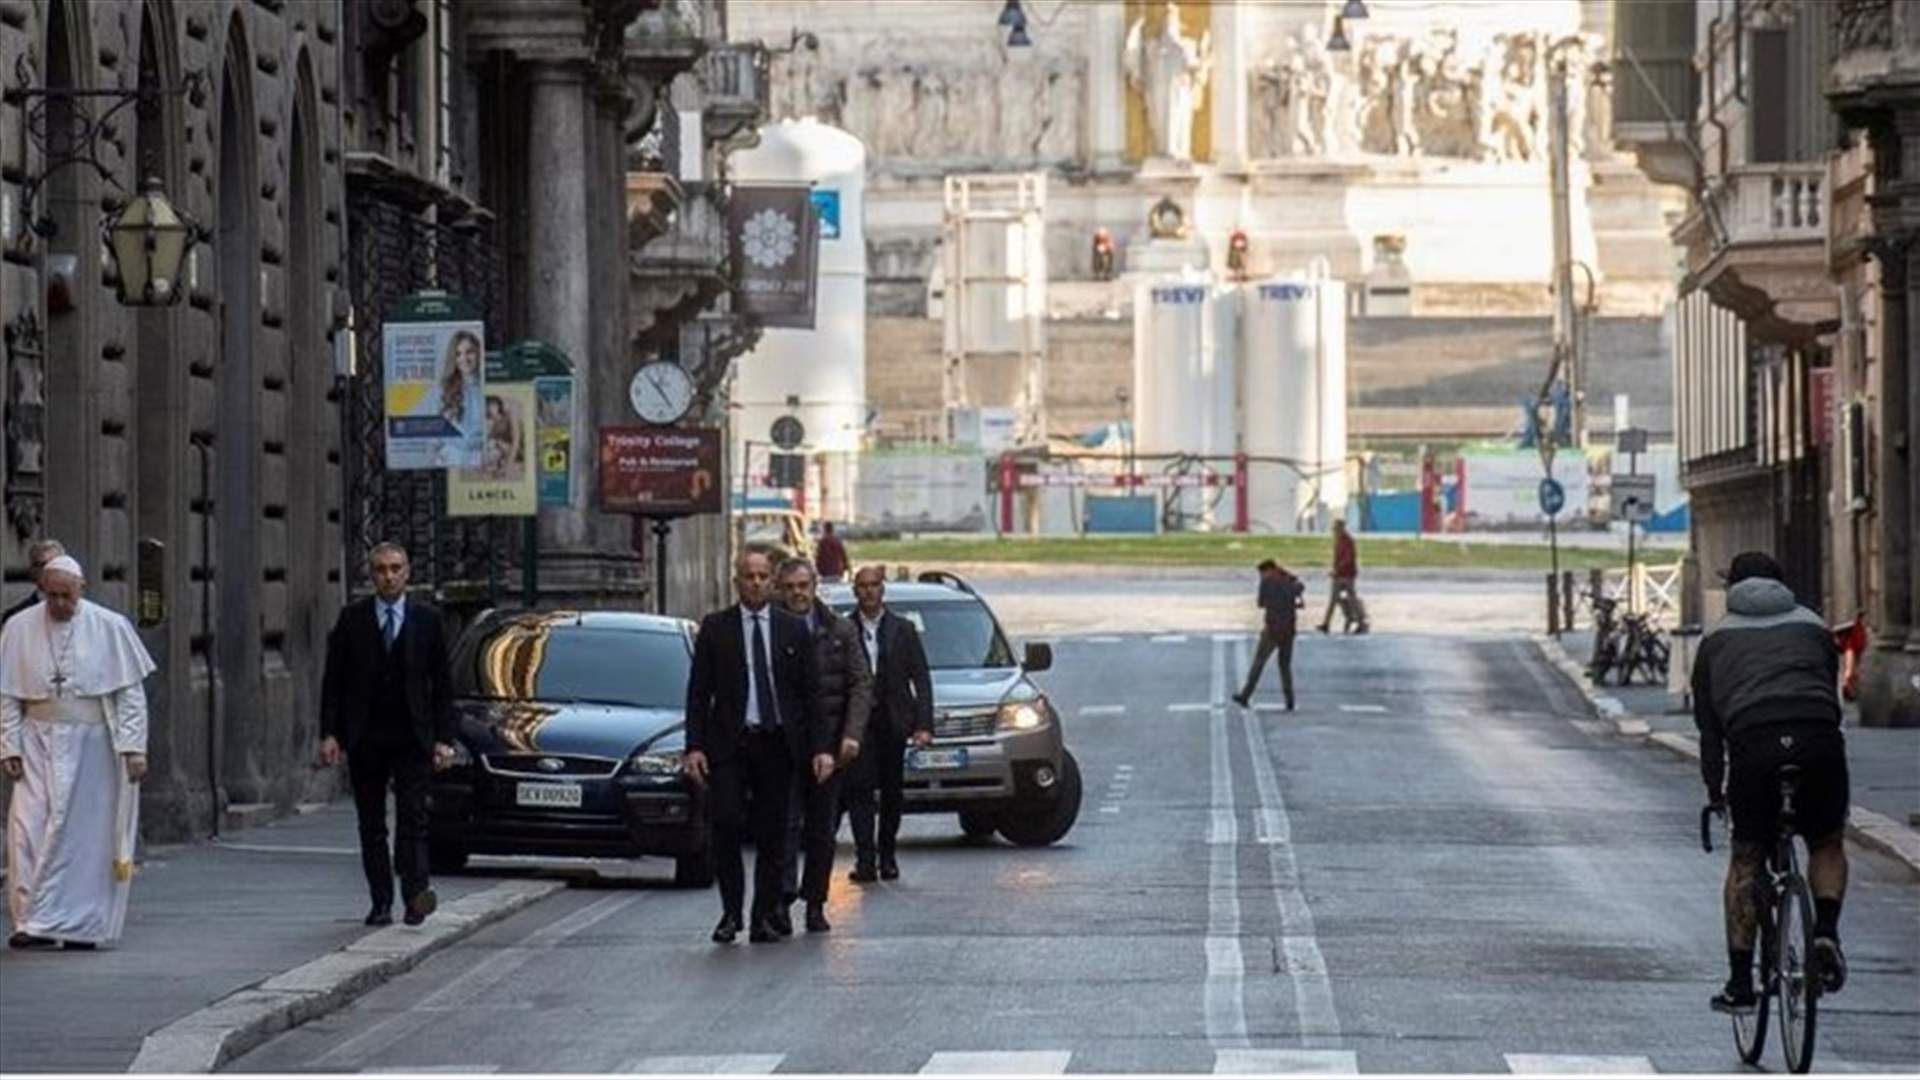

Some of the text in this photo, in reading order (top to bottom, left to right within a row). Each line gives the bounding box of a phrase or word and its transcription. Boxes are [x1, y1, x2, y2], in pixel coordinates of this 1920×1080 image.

[607, 435, 700, 449] Trinity College
[468, 488, 515, 501] LANCEL
